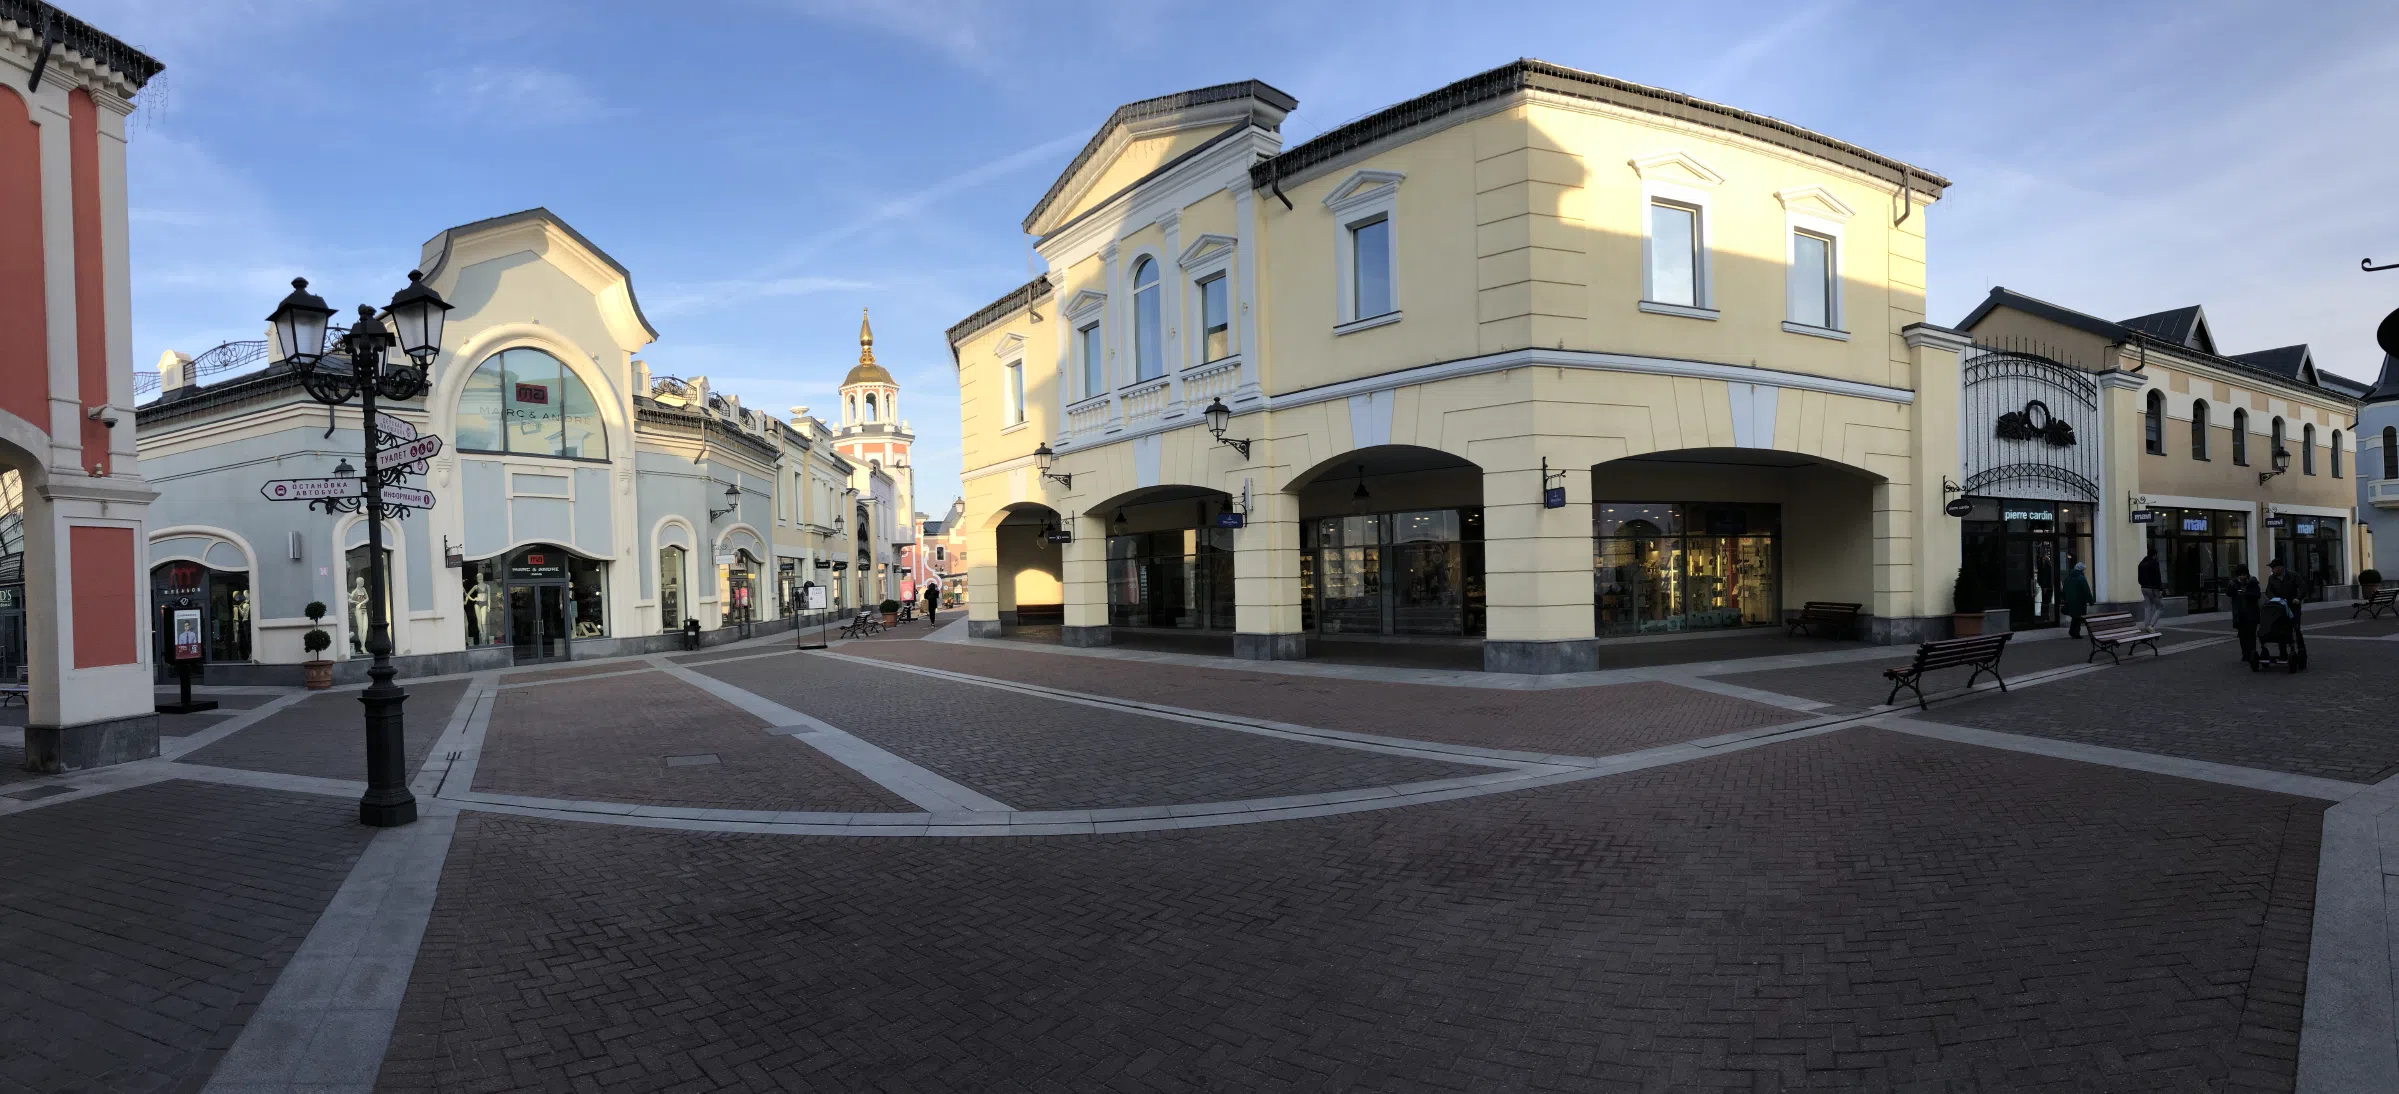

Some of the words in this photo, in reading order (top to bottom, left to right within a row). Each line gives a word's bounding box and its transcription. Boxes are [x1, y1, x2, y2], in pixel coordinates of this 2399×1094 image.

[529, 411, 537, 419] &
[380, 450, 407, 465] ТУАЛЕТ
[292, 482, 348, 490] ОСТАНОВКА
[296, 489, 345, 497] АВТОБУСА
[383, 490, 422, 502] ИНФОРМАЦИЯ
[2005, 509, 2028, 522] pierre
[2029, 510, 2053, 521] cardin
[2134, 512, 2152, 521] mavi
[2183, 516, 2207, 532] mavi
[2267, 518, 2284, 526] mavi
[2297, 522, 2315, 534] mavi
